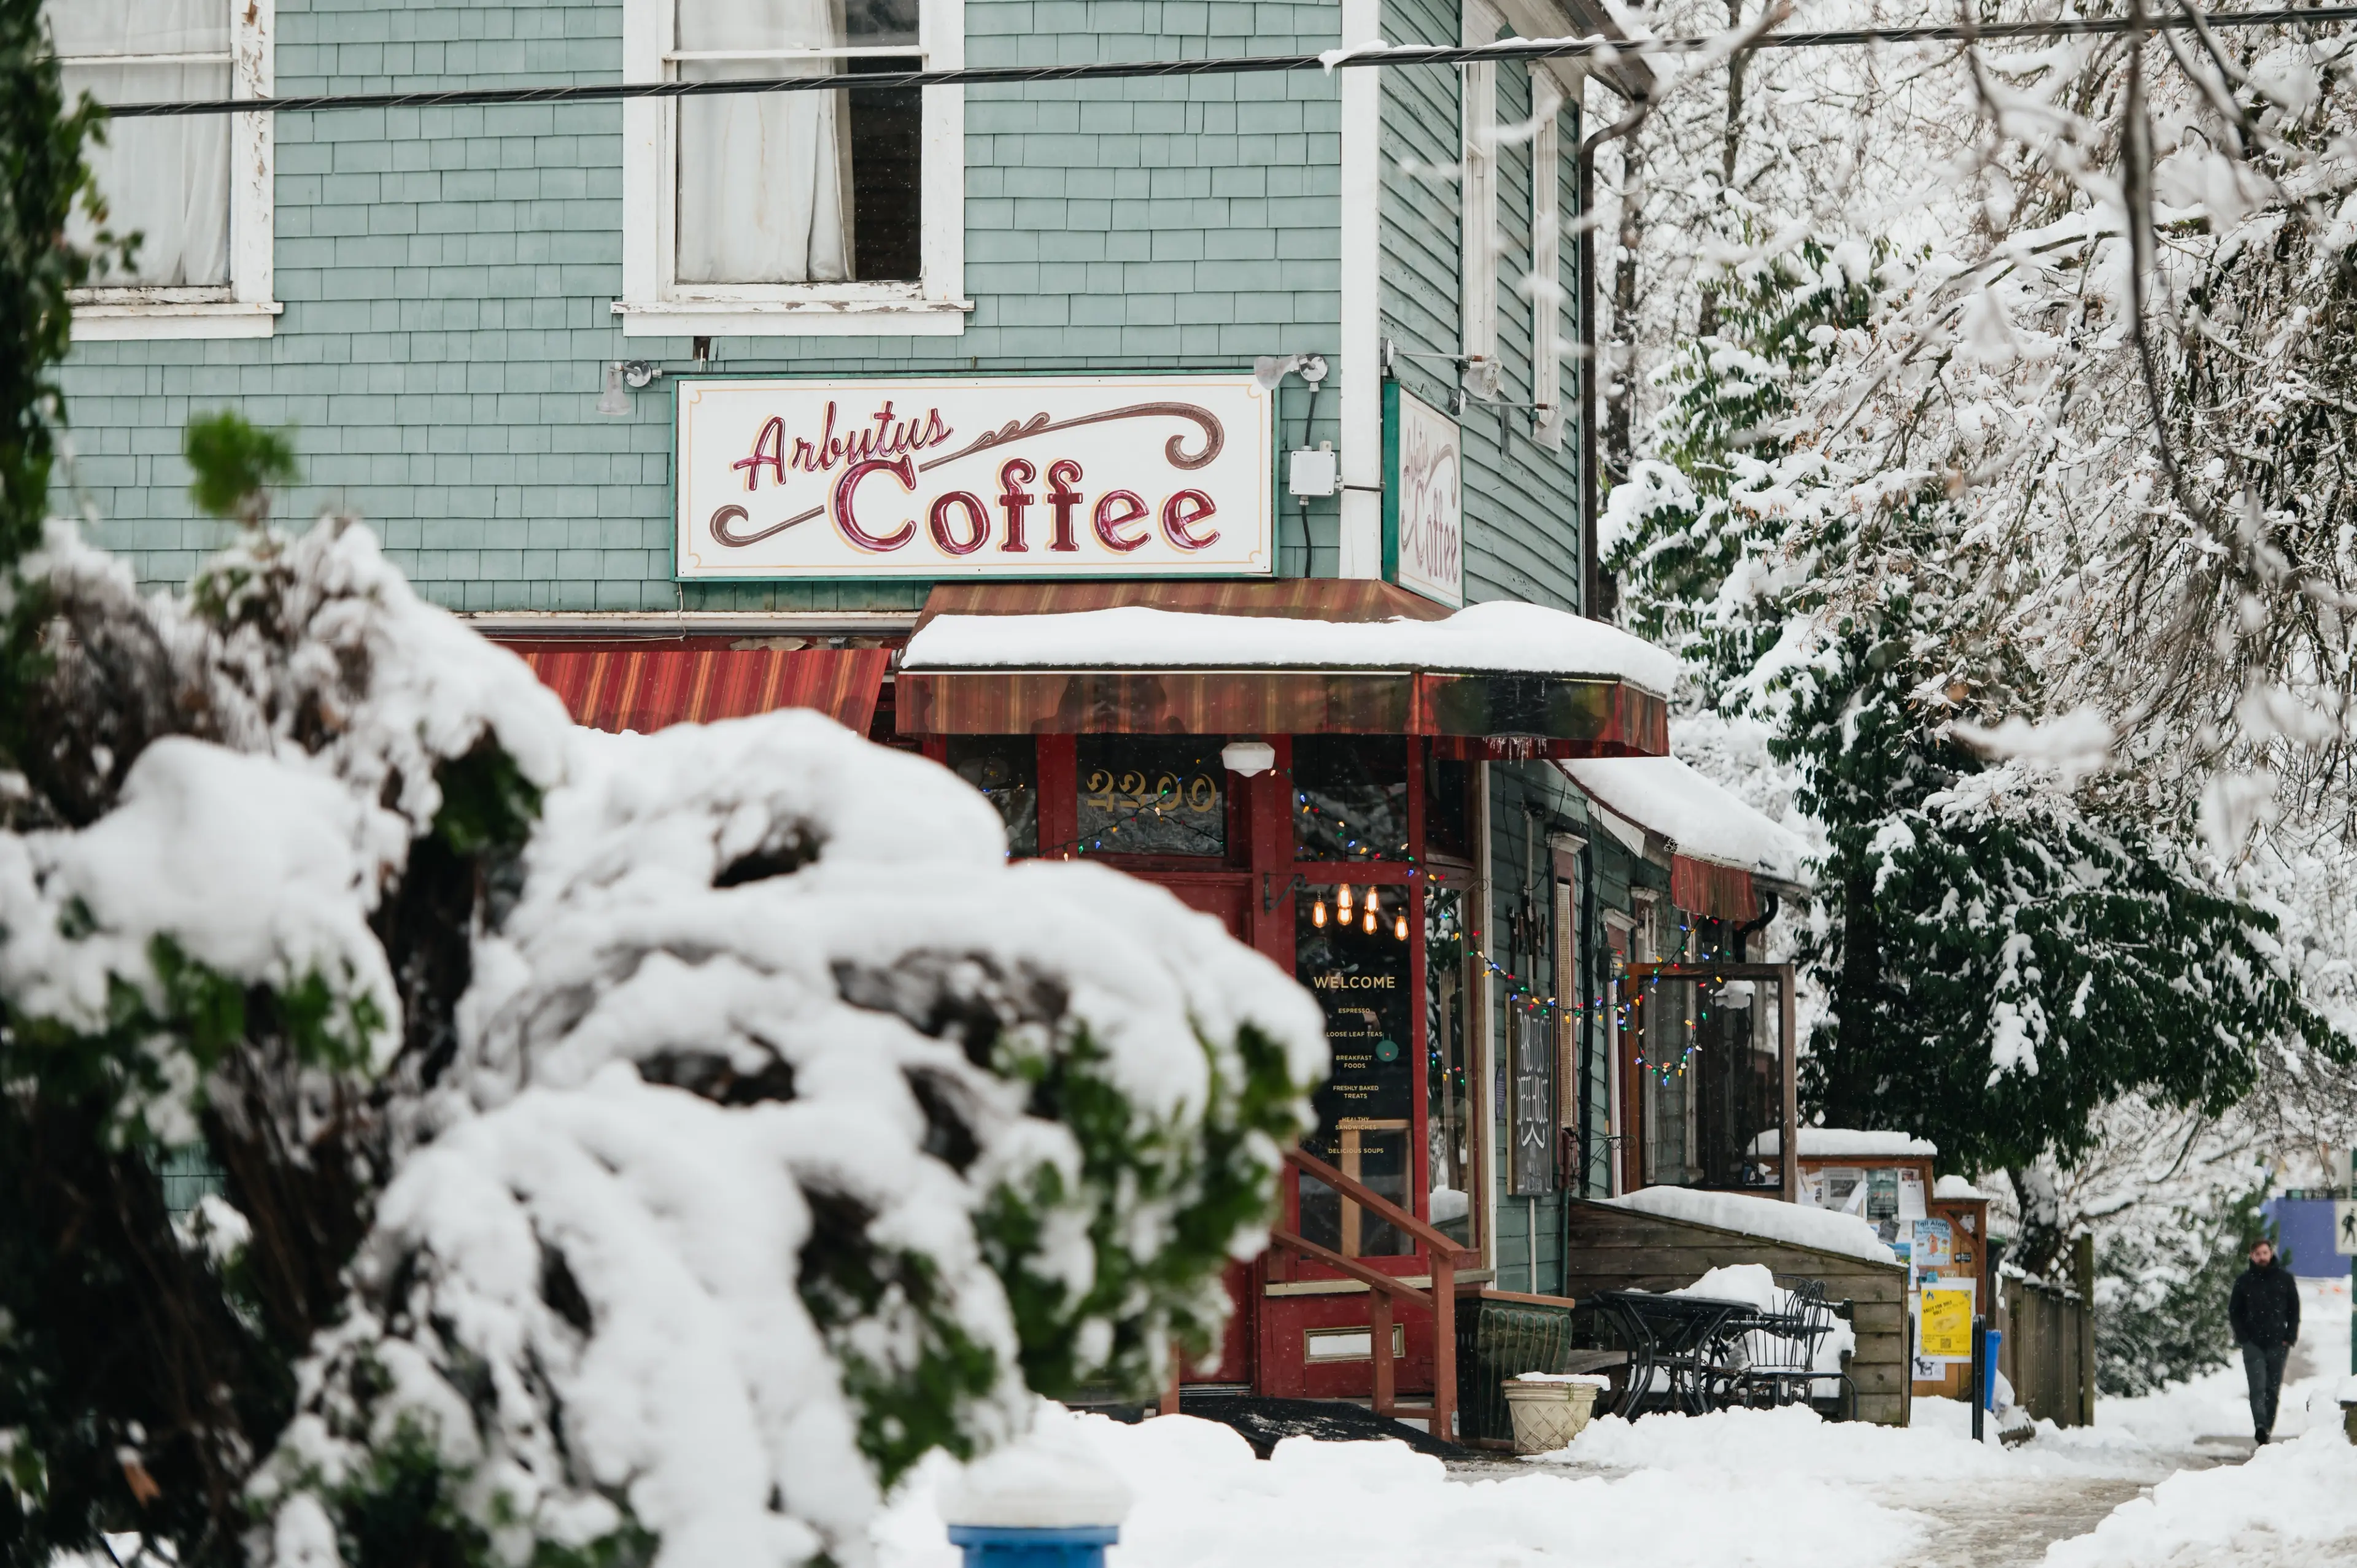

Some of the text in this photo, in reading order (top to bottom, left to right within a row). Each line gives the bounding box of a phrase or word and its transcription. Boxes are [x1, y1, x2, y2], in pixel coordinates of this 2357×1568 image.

[730, 401, 954, 491] Arbutus
[1403, 416, 1429, 498] Arbutus
[831, 454, 1221, 555] Coffee
[1415, 478, 1457, 583] Coffee
[1086, 769, 1217, 814] 2200
[1314, 976, 1395, 989] WELCOME
